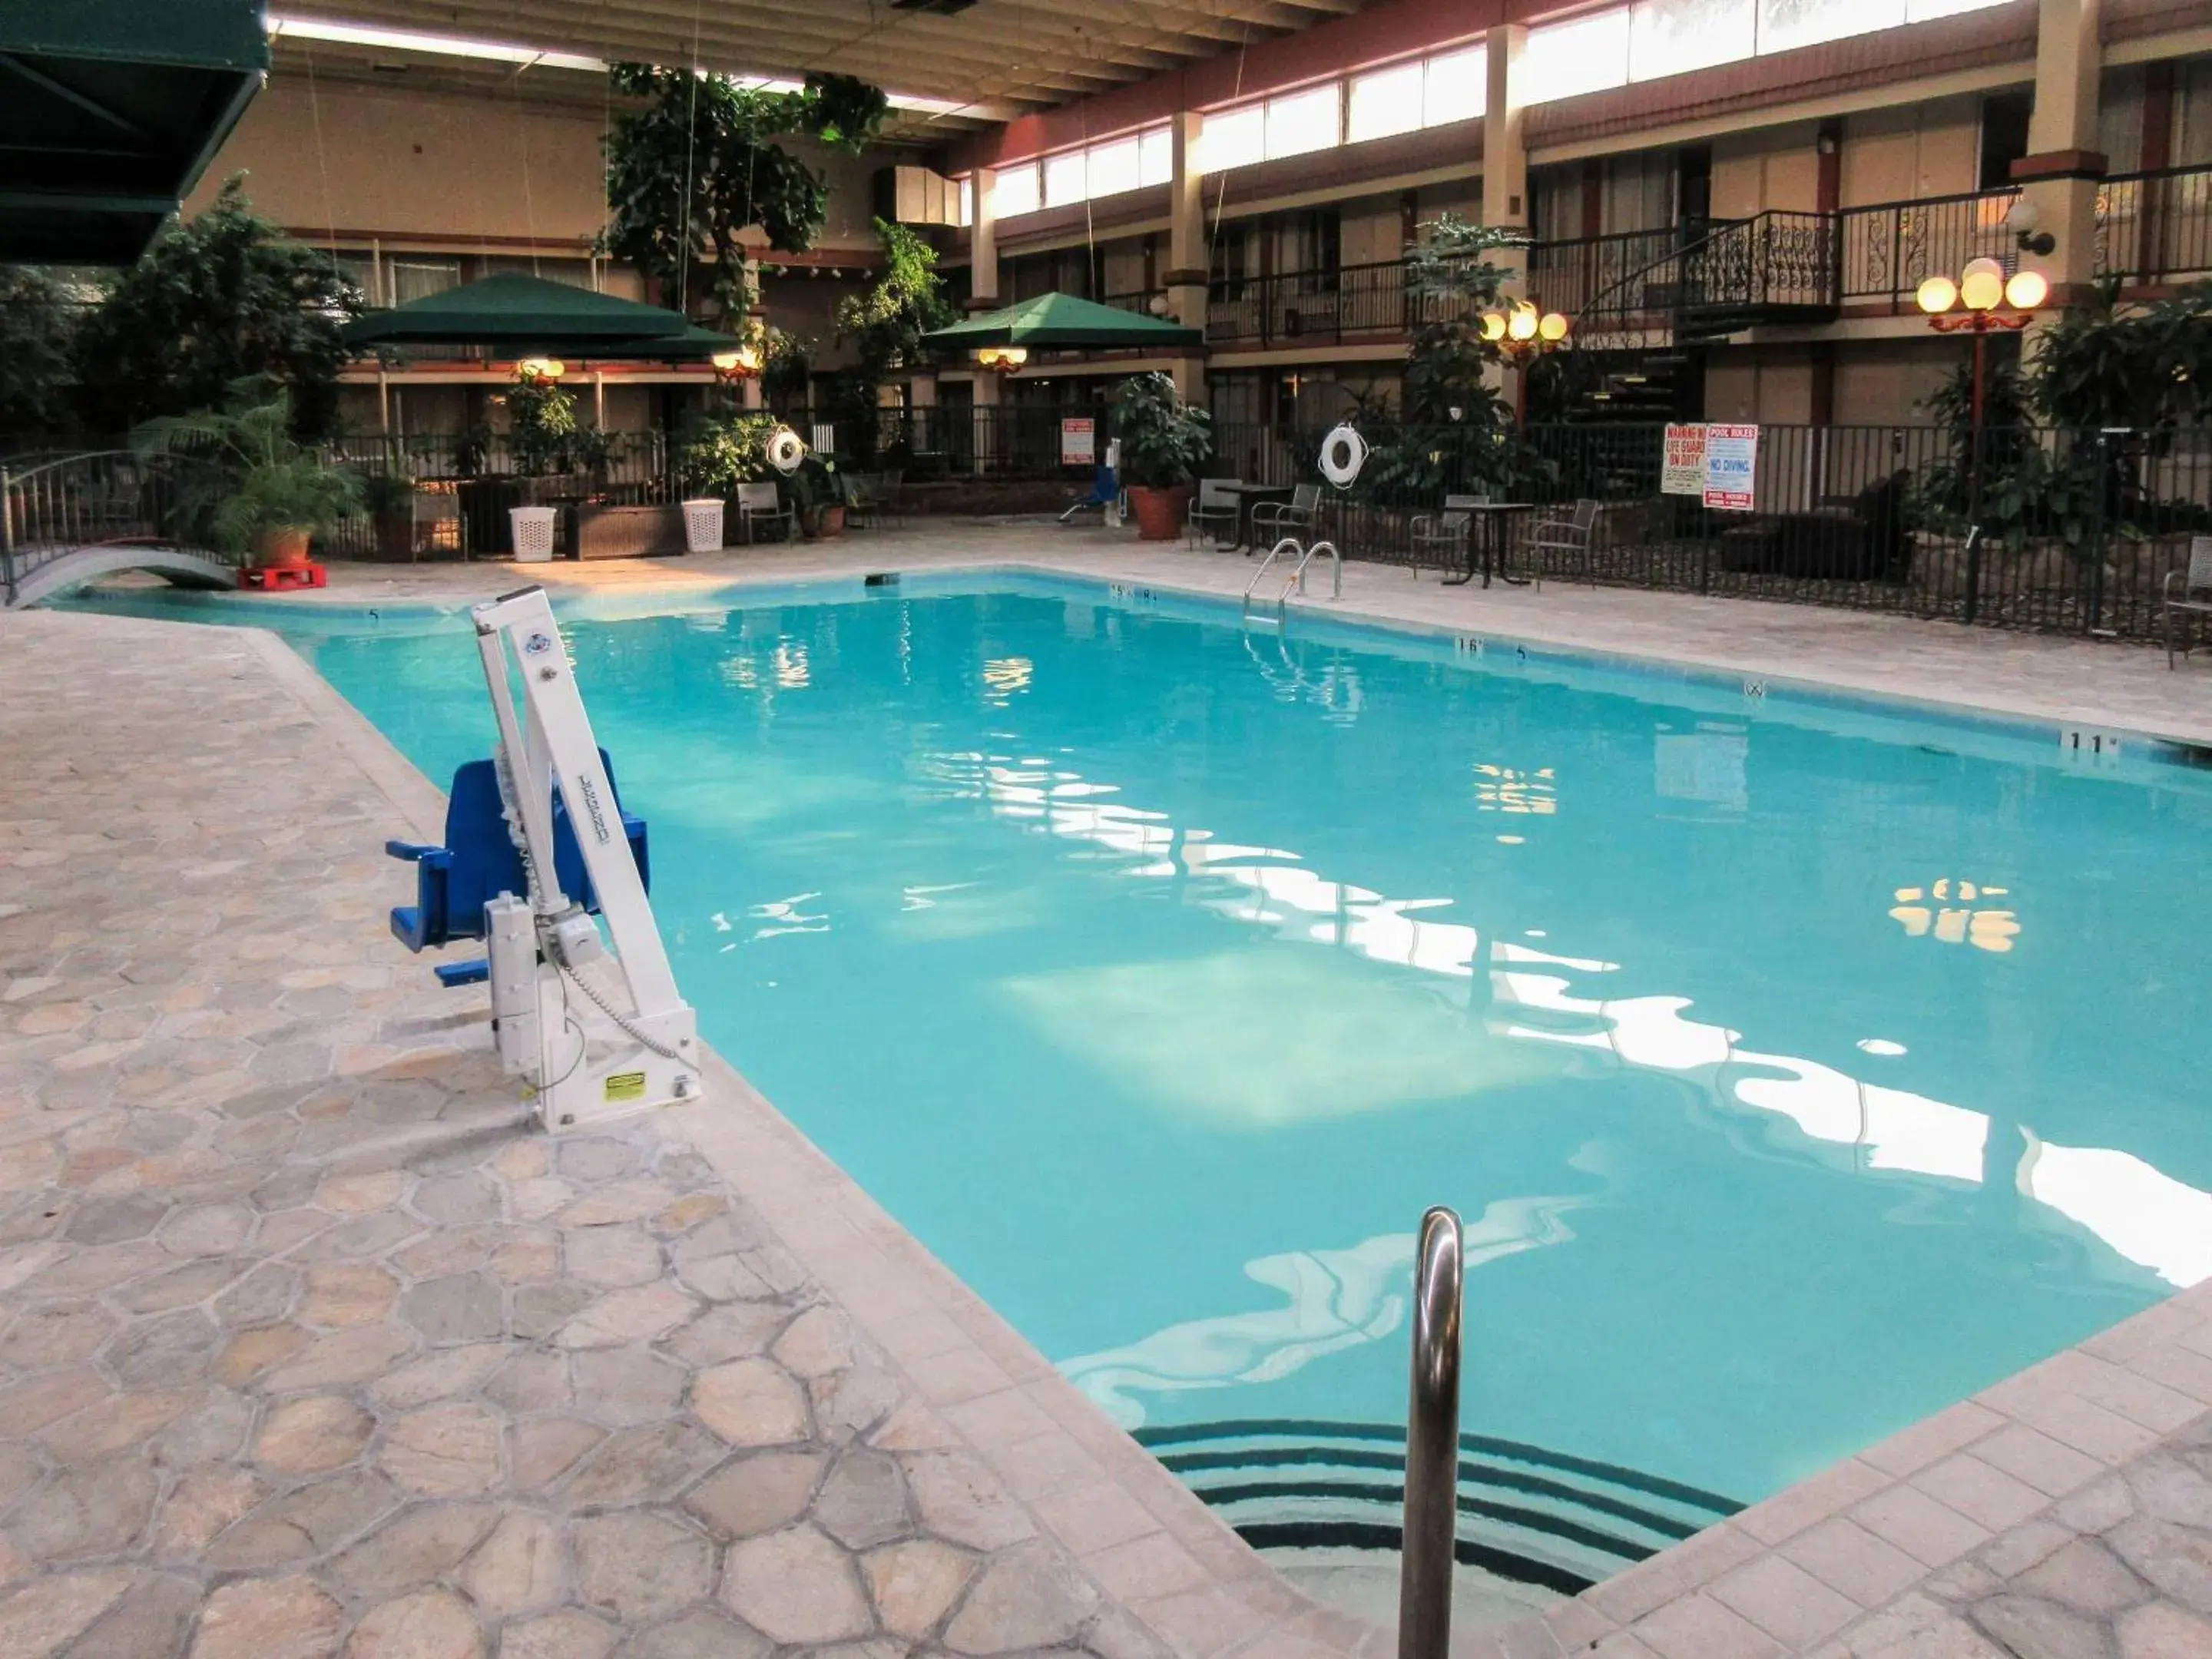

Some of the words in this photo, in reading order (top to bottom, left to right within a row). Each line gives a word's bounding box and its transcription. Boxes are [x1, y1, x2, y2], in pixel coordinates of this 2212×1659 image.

[1710, 429, 1727, 437] POOL
[1730, 429, 1754, 438] RULES
[1710, 459, 1721, 470] NO
